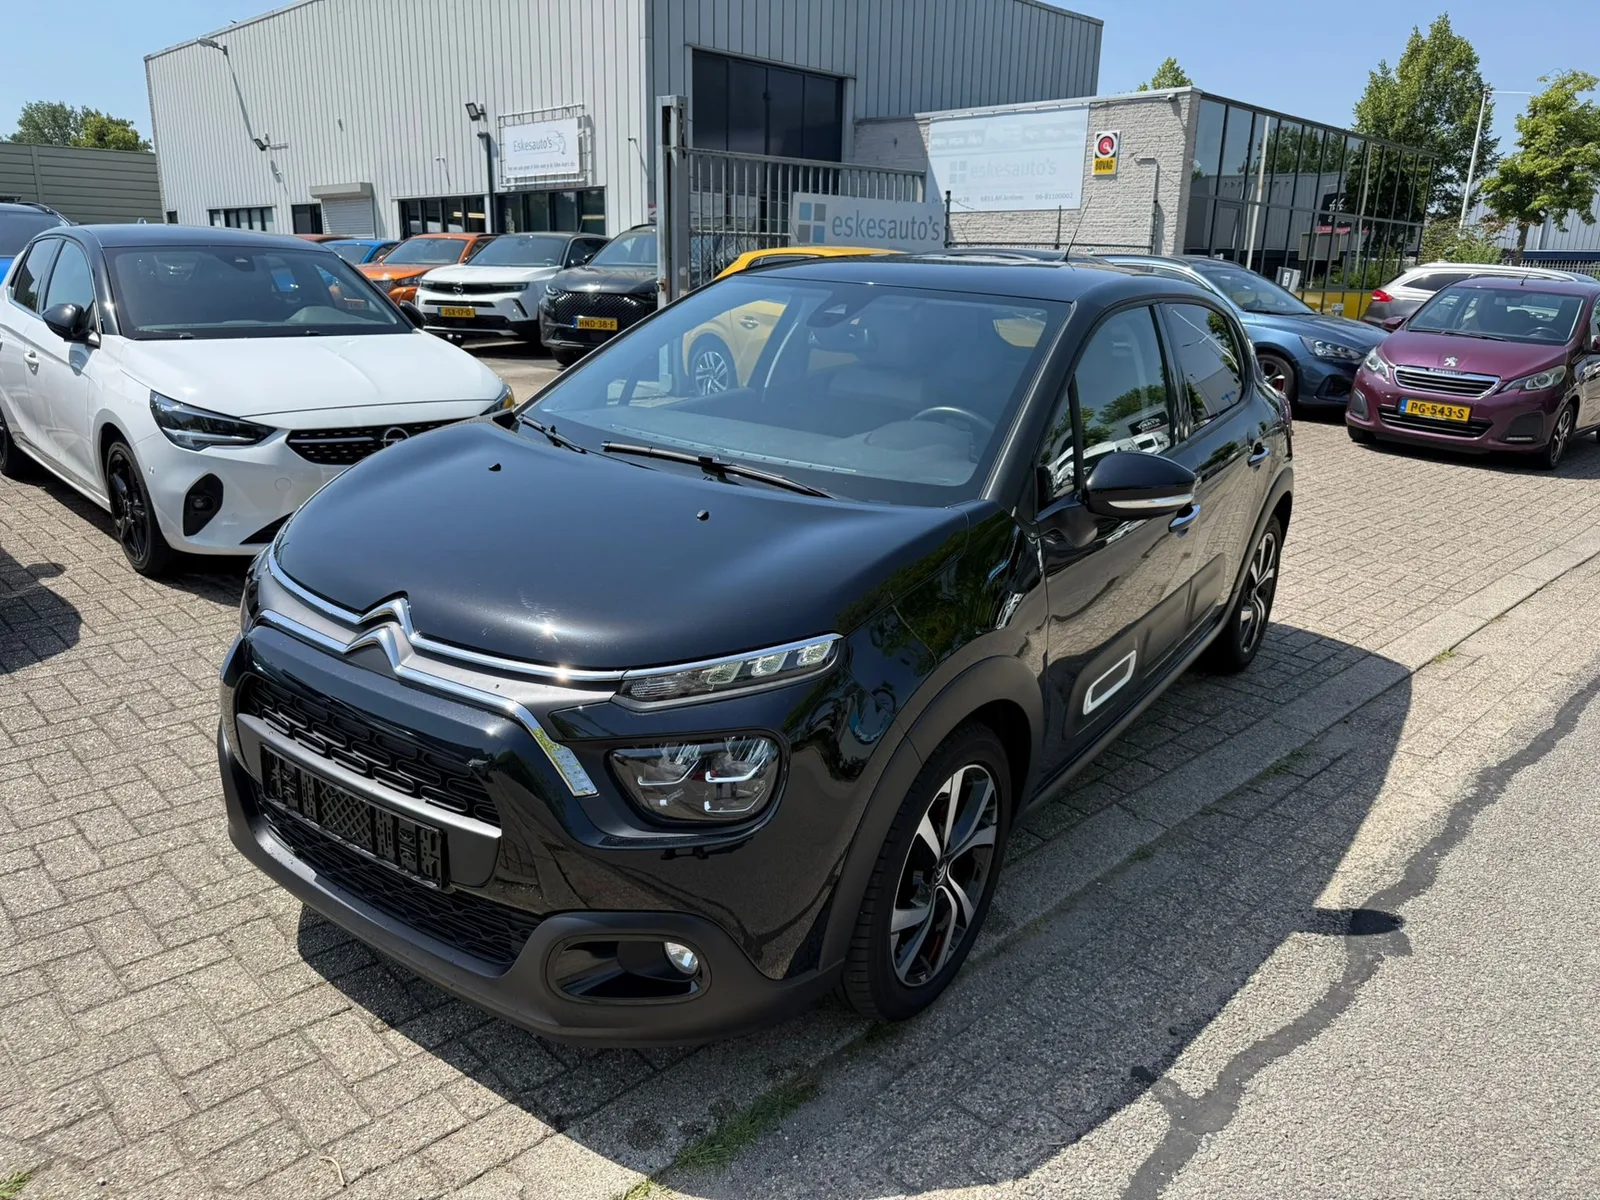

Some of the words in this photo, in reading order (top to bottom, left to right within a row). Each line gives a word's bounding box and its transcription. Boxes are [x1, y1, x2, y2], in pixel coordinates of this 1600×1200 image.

[513, 136, 553, 153] Eskesauto's
[970, 157, 1057, 179] eskesauto's
[1095, 159, 1114, 171] BOVAG
[831, 209, 940, 241] eskesauto's
[579, 319, 616, 329] HND-38-F
[1410, 402, 1465, 419] PG-543-S
